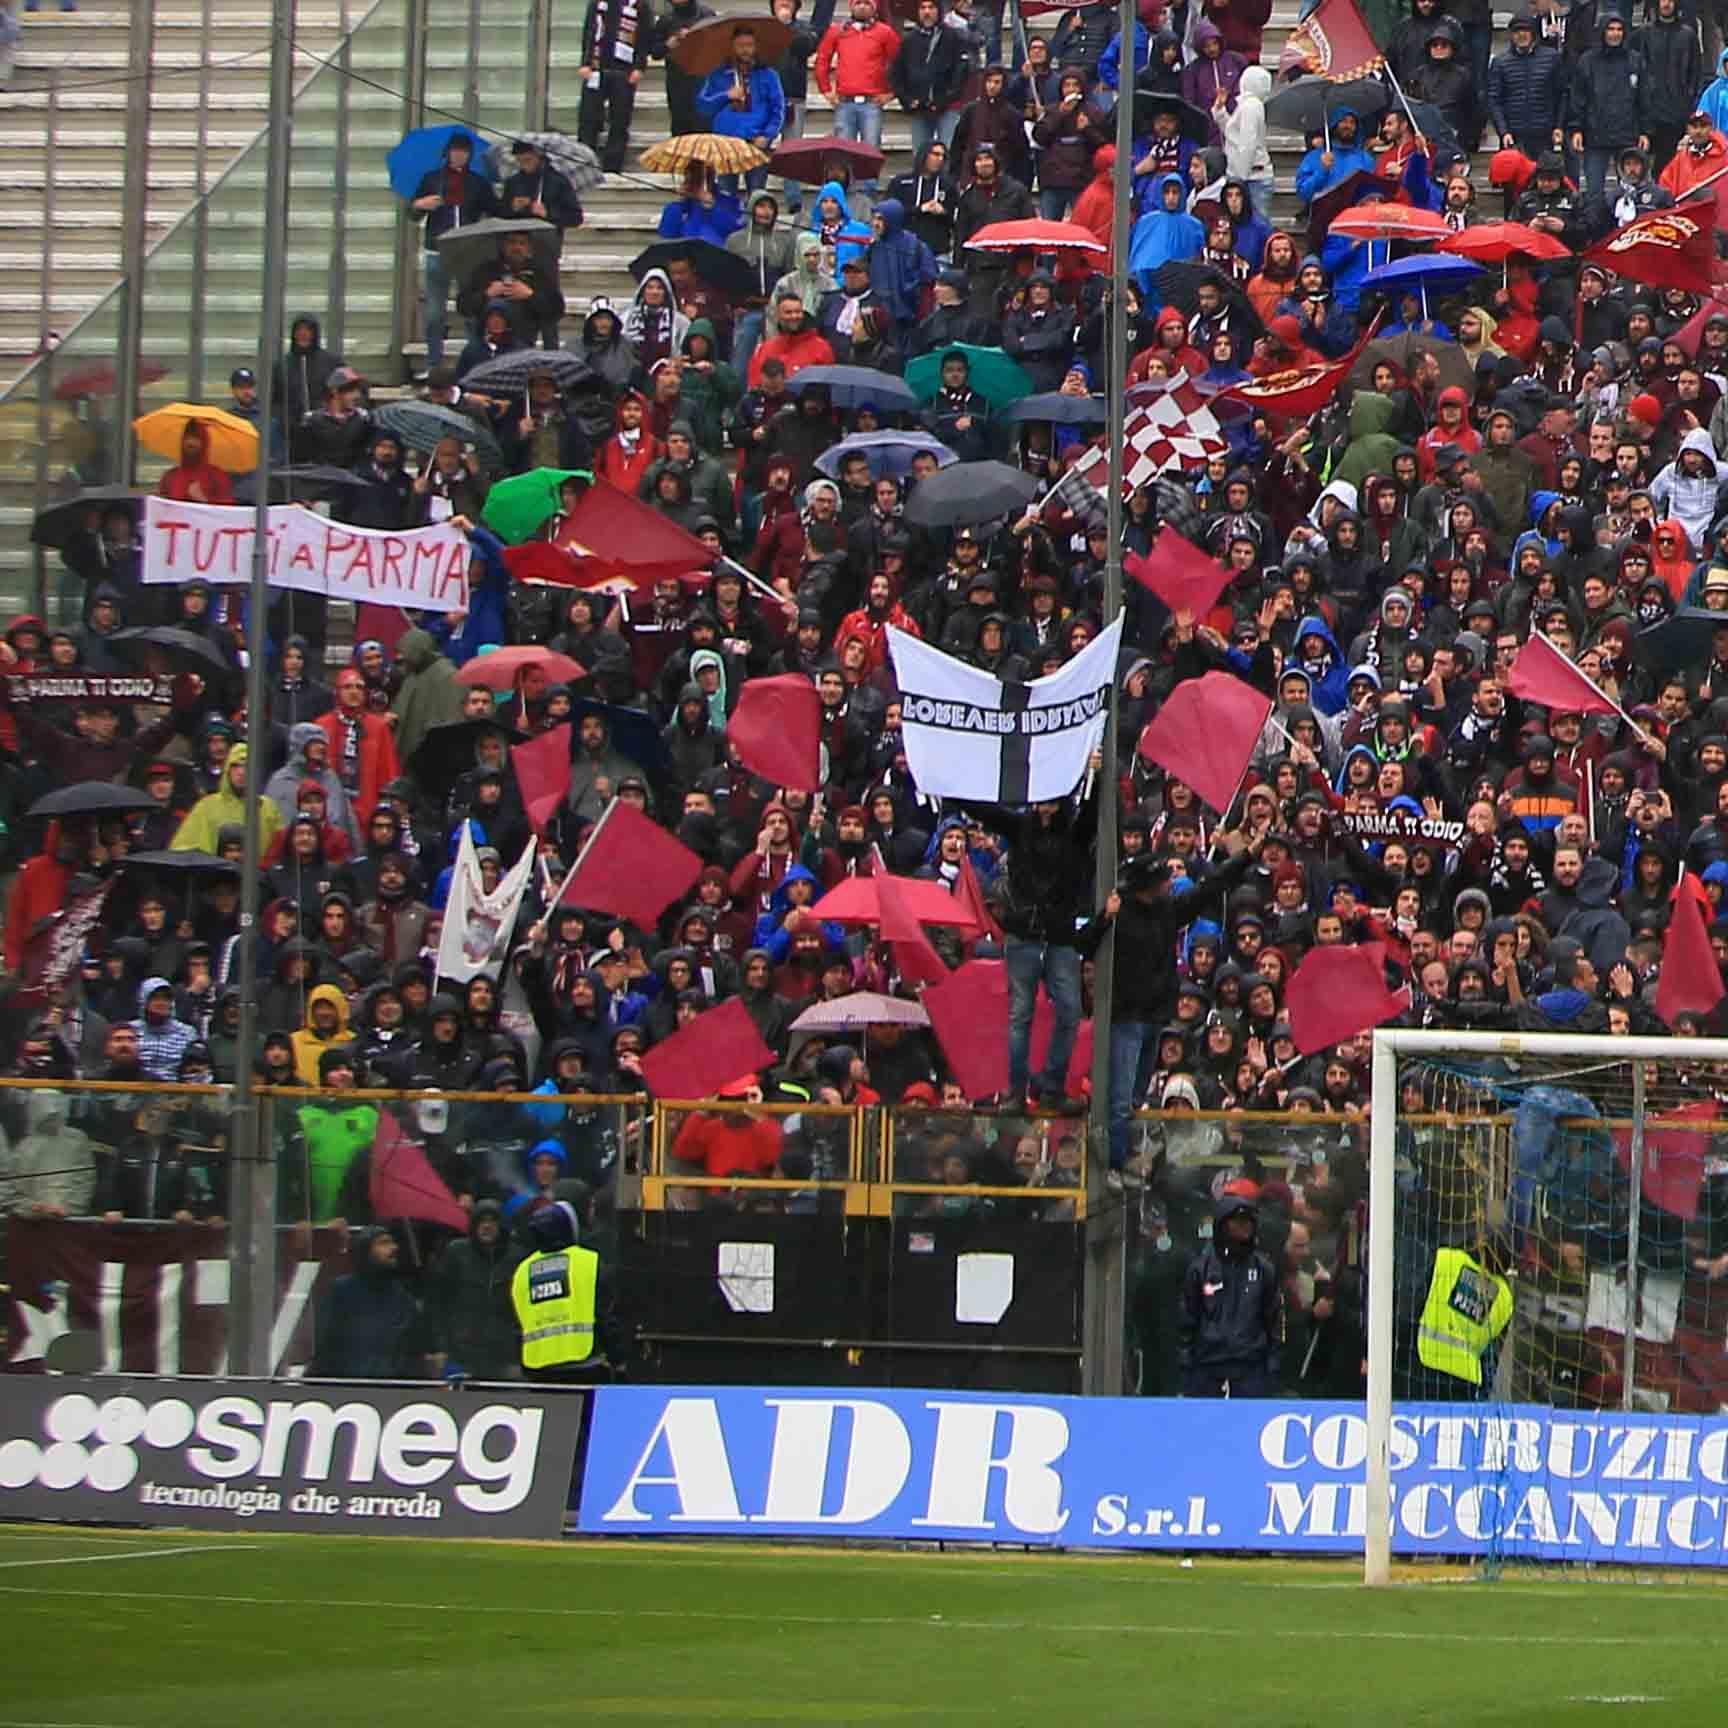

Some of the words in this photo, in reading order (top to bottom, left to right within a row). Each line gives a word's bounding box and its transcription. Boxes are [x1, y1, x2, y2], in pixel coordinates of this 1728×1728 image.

[323, 525, 468, 606] PARMA
[29, 679, 88, 698] PARMA
[108, 678, 153, 698] ODIO
[1345, 813, 1400, 835] PARMA
[1422, 819, 1463, 842] ODIO
[188, 1395, 543, 1512] smeg
[603, 1397, 1070, 1535] ADR
[1092, 1495, 1221, 1538] S.r.l.
[140, 1480, 282, 1516] tecnologia
[291, 1485, 338, 1515] che
[348, 1490, 442, 1520] arreda
